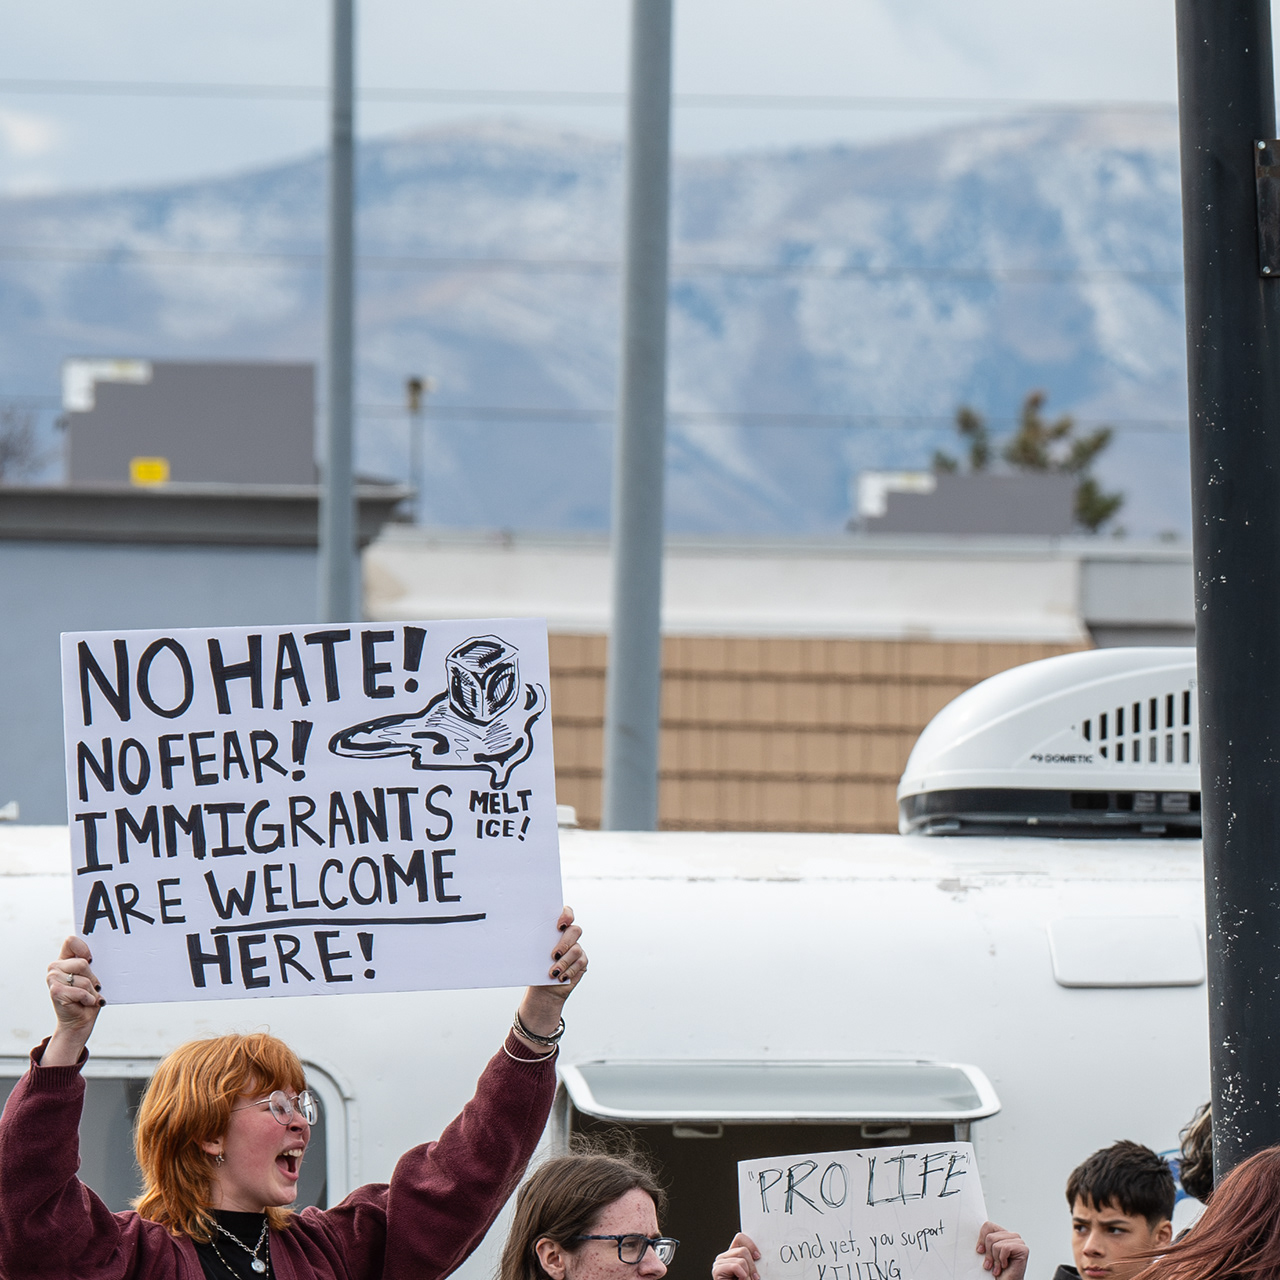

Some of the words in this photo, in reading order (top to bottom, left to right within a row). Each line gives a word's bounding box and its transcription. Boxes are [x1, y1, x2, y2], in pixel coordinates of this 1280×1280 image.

[78, 638, 194, 727] NO
[207, 627, 427, 715] HATE!
[77, 737, 151, 802] NO
[159, 720, 314, 790] FEAR!
[75, 785, 454, 875] IMMIGRANTS
[469, 789, 533, 816] MELT
[476, 816, 531, 842] ICE!
[82, 879, 186, 936] ARE
[204, 849, 462, 919] WELCOME
[186, 932, 376, 990] HERE!
[780, 1234, 825, 1264] and
[830, 1230, 861, 1257] yet,
[870, 1233, 894, 1263] you
[901, 1219, 945, 1253] support
